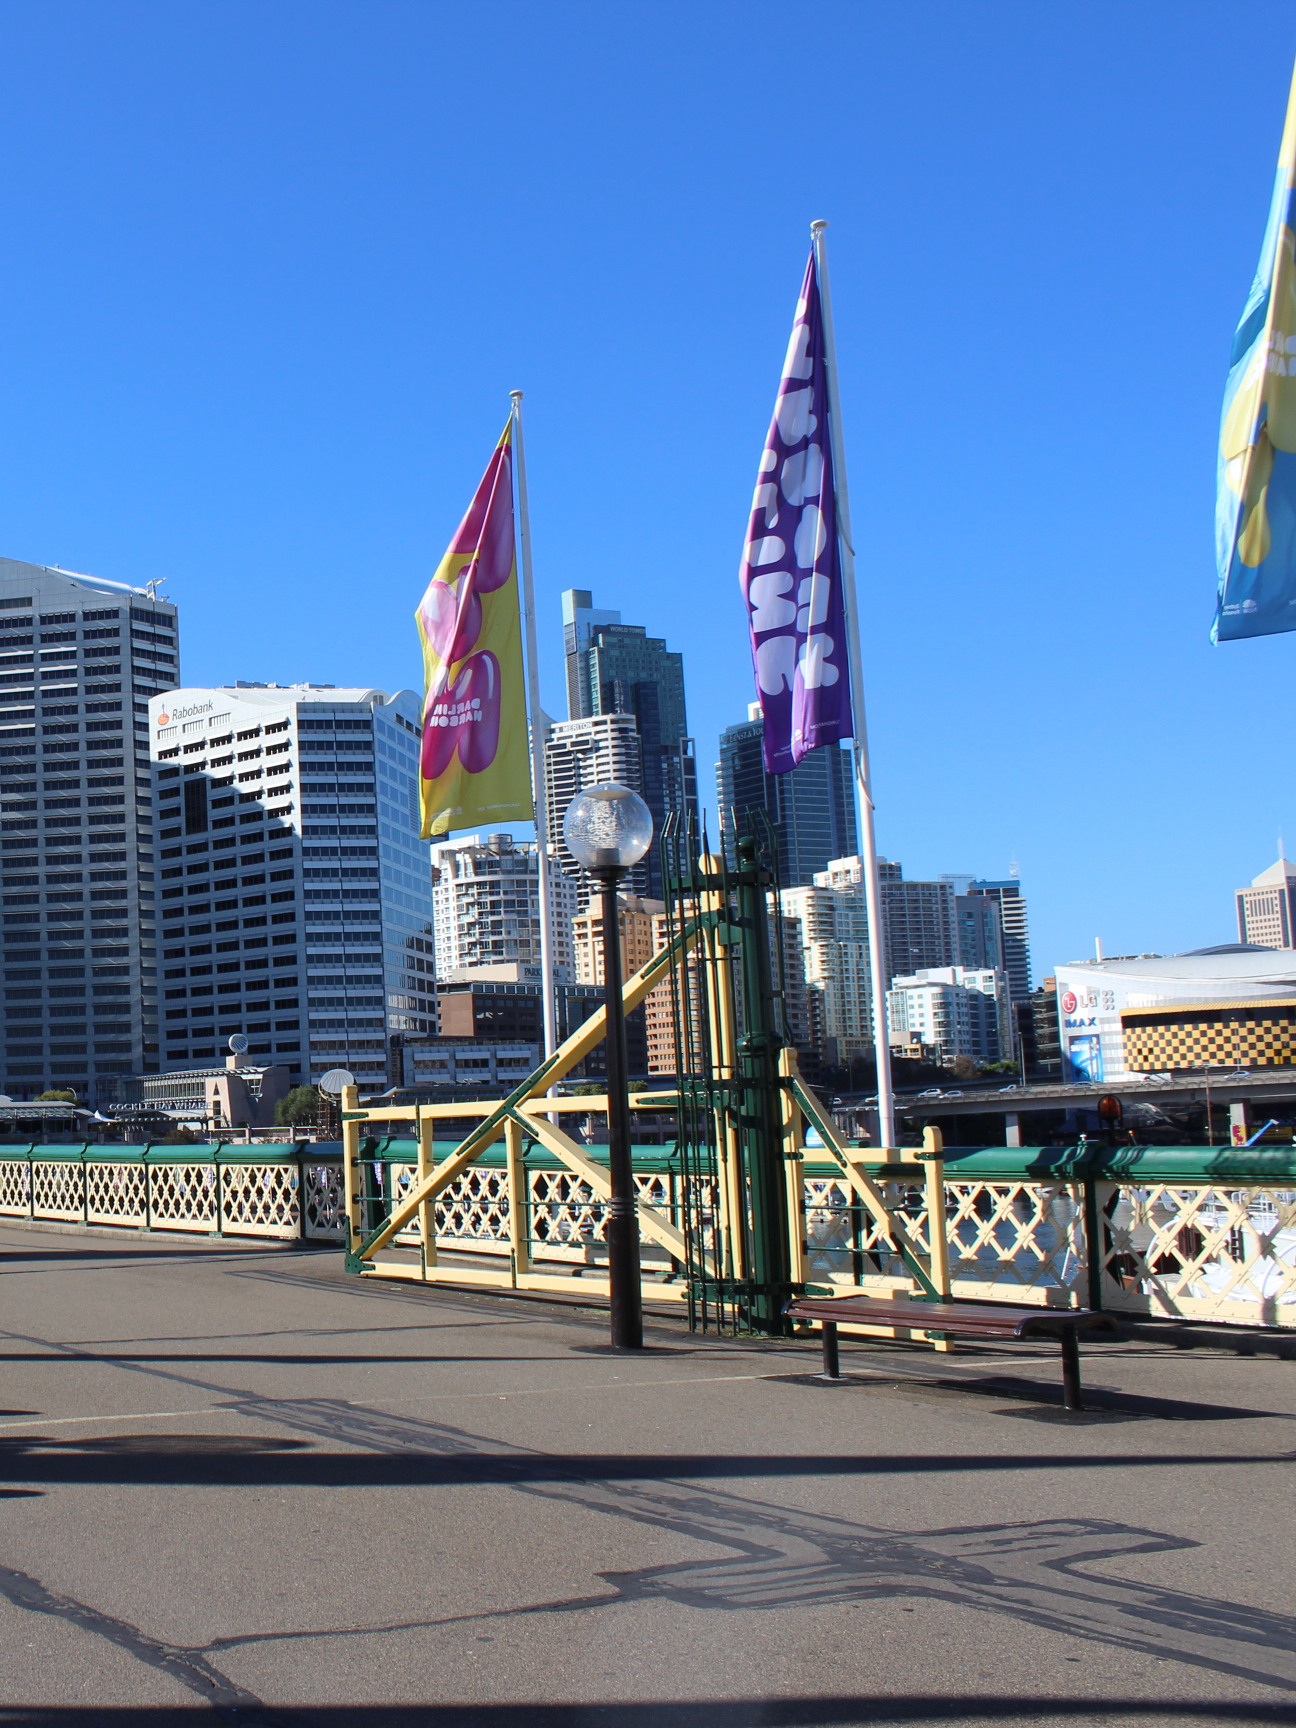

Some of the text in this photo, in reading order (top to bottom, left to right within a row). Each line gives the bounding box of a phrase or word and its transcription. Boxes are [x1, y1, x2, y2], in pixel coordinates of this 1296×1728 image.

[172, 700, 214, 721] Rabobank
[562, 722, 592, 732] MERITON
[729, 730, 748, 743] ERNST
[1079, 994, 1098, 1009] LG
[1064, 1017, 1098, 1028] IMAX
[109, 1101, 212, 1112] COCKLE BAY WHARF
